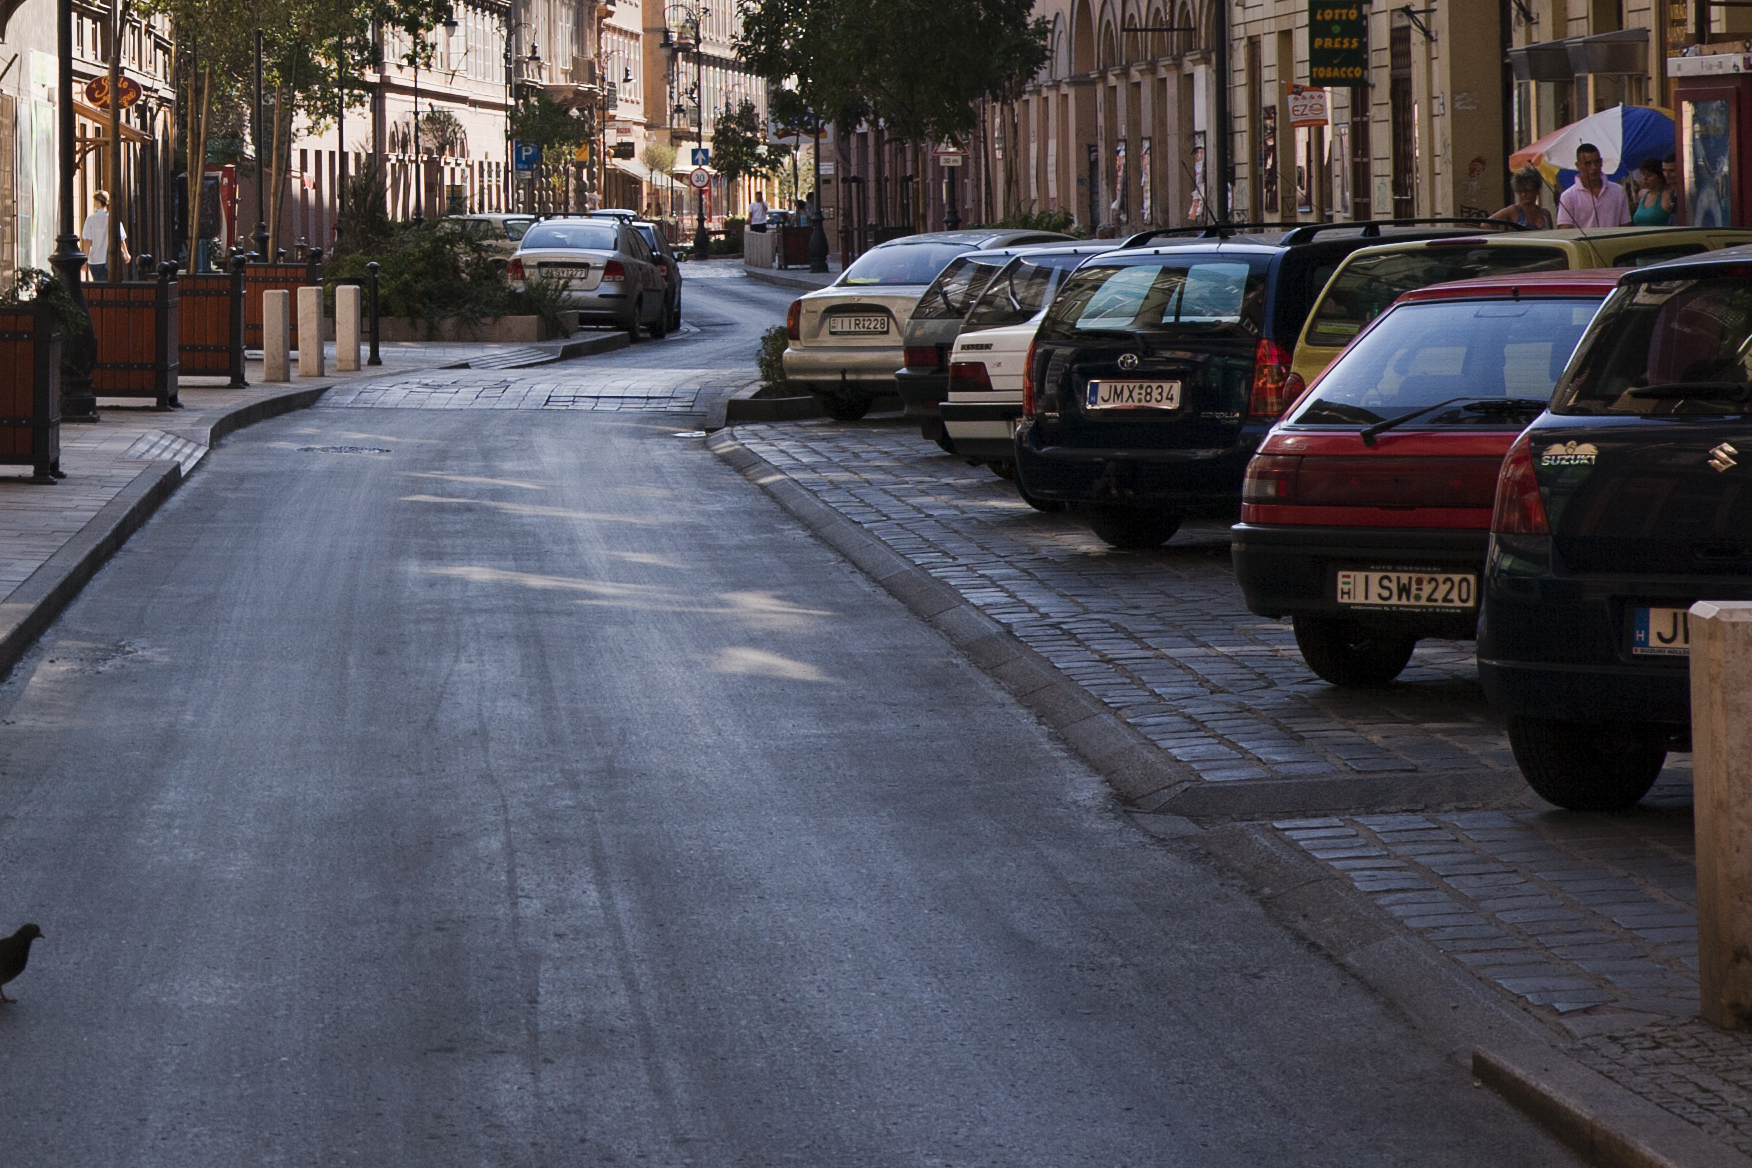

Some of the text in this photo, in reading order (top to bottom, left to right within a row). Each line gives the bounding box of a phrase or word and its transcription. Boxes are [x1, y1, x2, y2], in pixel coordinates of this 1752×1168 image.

[1316, 4, 1358, 21] LOTTÓ
[1314, 38, 1359, 49] PRESS
[1312, 67, 1361, 79] TOBACCO
[522, 146, 532, 160] P
[695, 173, 705, 183] 30
[1542, 455, 1596, 466] SUZUKI
